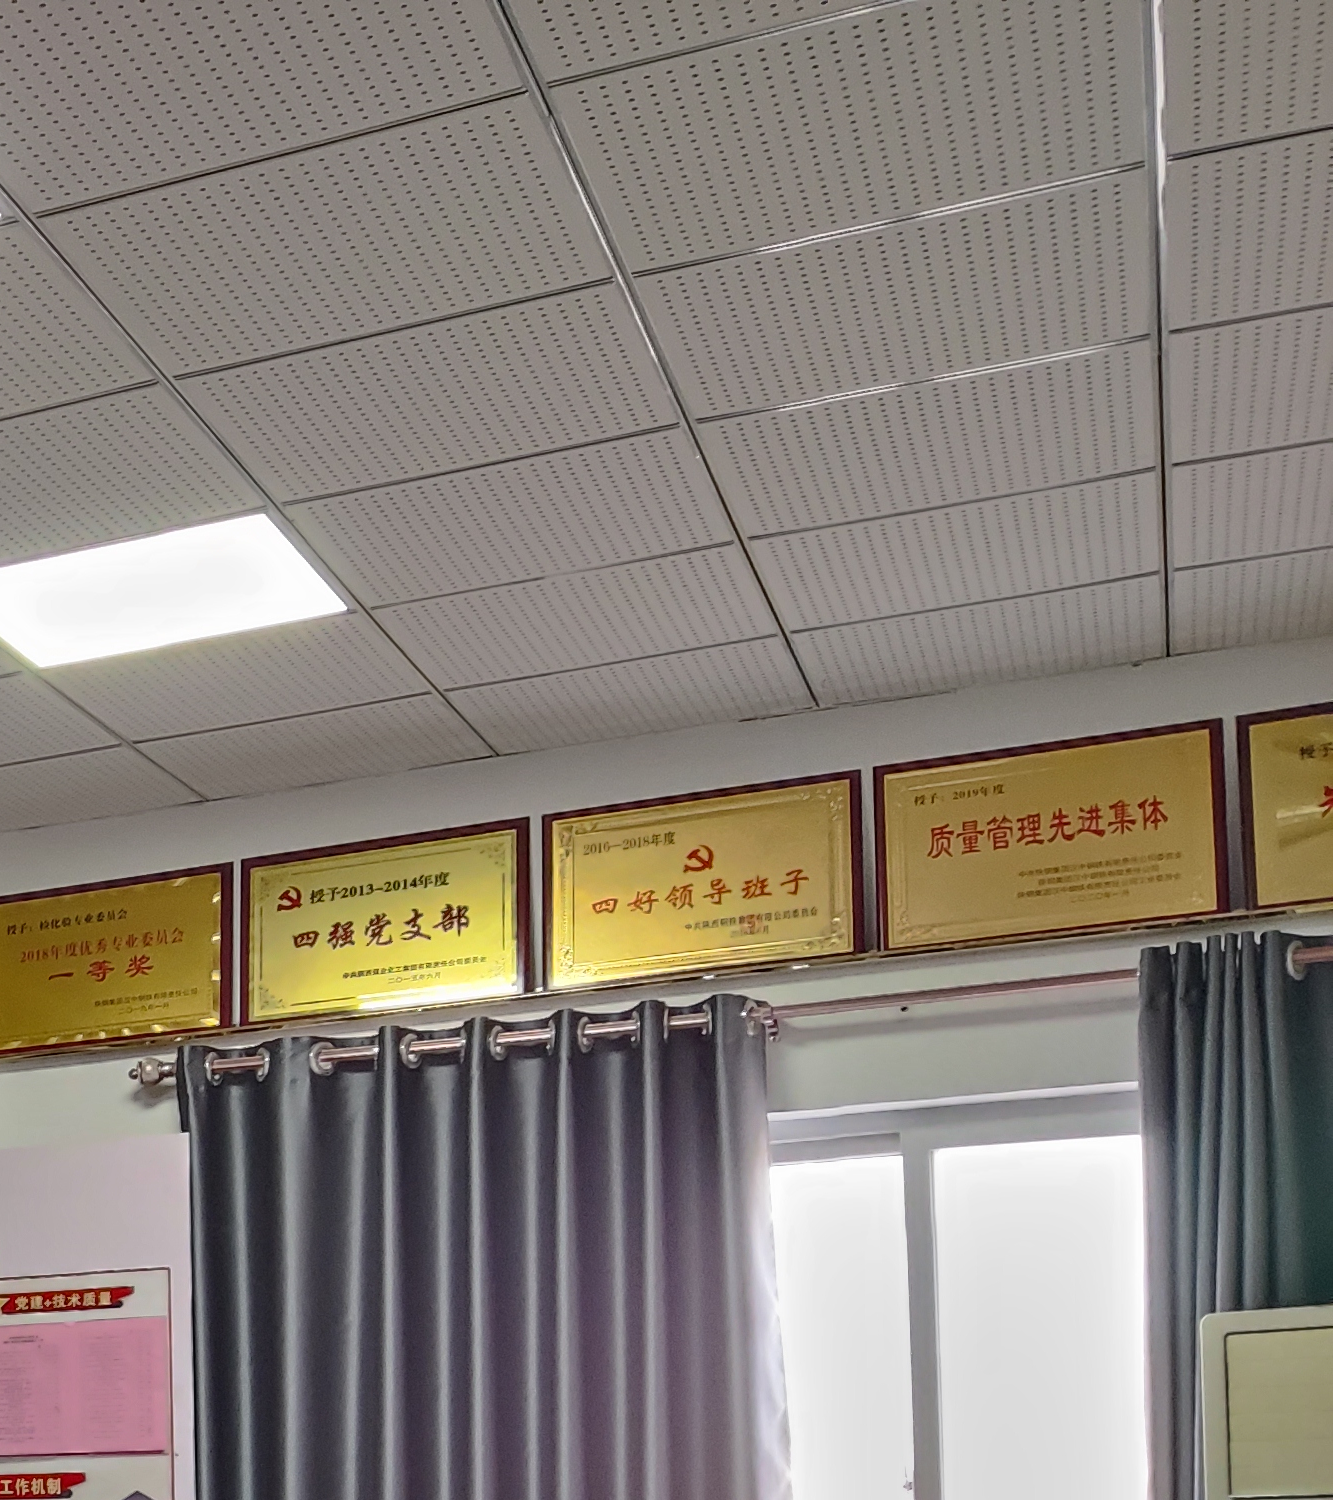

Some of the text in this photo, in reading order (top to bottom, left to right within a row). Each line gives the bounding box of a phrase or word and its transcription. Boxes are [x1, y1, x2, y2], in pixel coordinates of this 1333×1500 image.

[927, 794, 1169, 860] 质量管理先进集体
[591, 868, 810, 915] 四好领导班子
[20, 926, 185, 963] 2018年度优秀专业委员会
[293, 902, 470, 951] 四强党支部
[48, 953, 154, 983] 一等奖
[14, 1291, 112, 1312] 党建+技术质量
